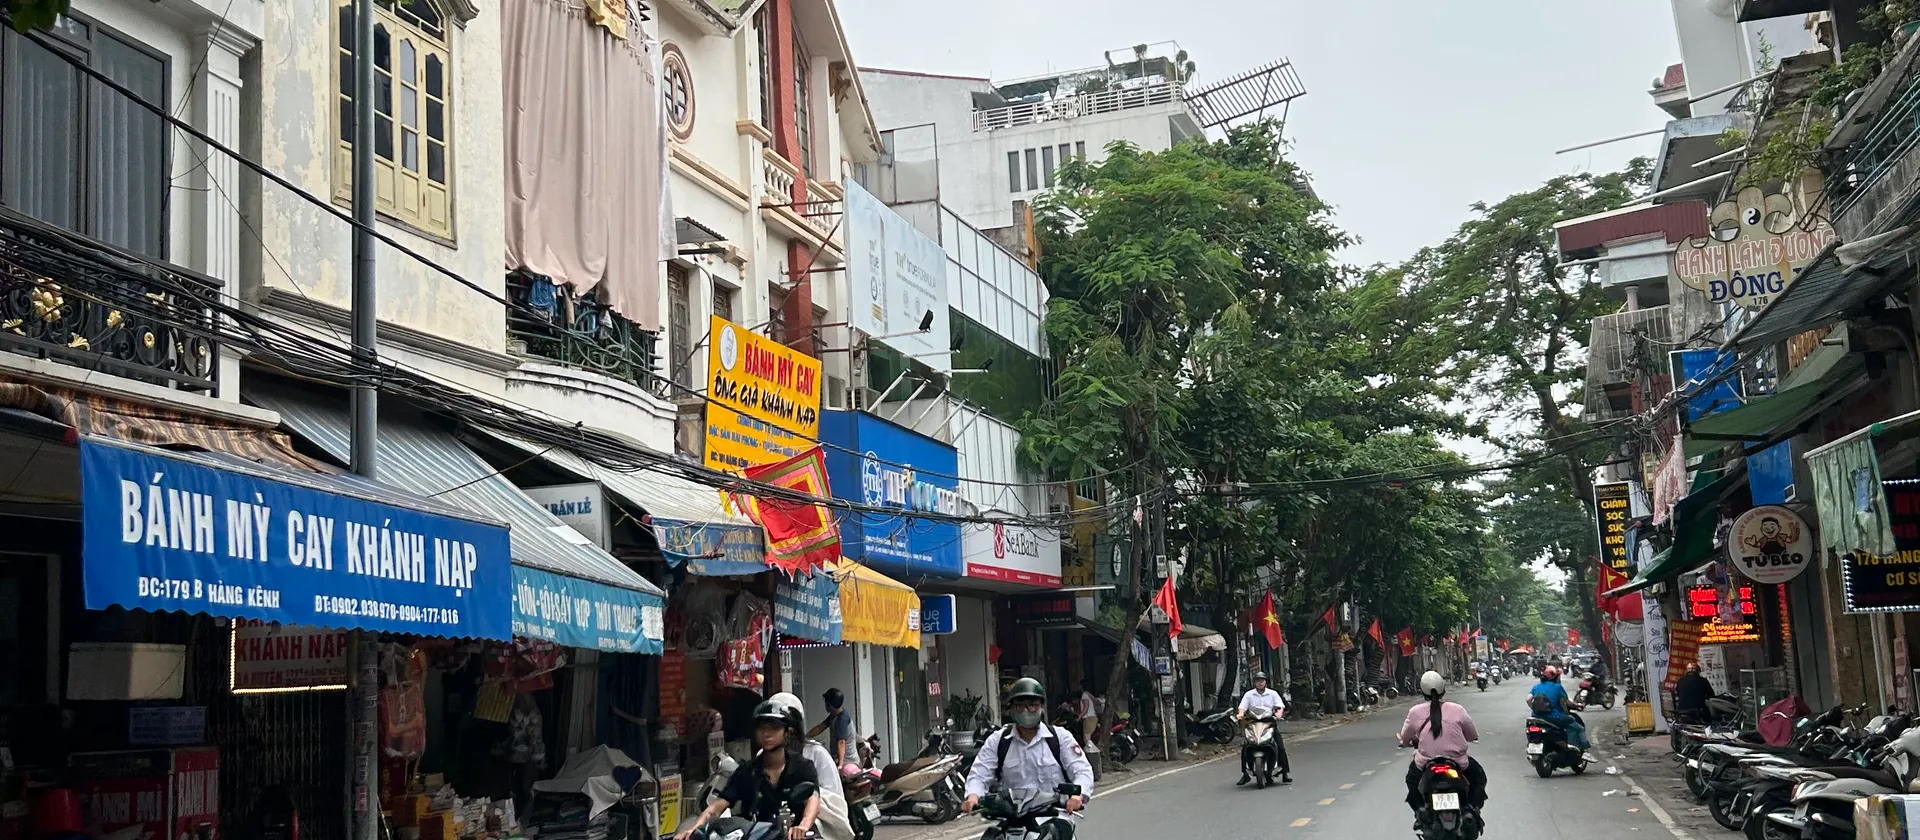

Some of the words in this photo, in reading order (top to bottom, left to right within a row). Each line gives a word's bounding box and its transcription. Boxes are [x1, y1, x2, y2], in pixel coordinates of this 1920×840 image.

[1676, 245, 1728, 283] HẠNH
[1729, 235, 1767, 273] LÂM
[1709, 270, 1784, 301] ĐÔNG
[1753, 296, 1768, 305] 176
[744, 339, 775, 382] BÁNH
[796, 364, 815, 396] CAY
[714, 368, 737, 403] ÔNG
[740, 381, 759, 408] GIÀ
[761, 389, 794, 421] KHÁNH
[121, 473, 215, 555] BÁNH
[226, 492, 271, 562] MỲ
[287, 513, 334, 571] CAY
[346, 518, 426, 584] KHÁNH
[434, 537, 478, 598] NẠP
[1006, 529, 1039, 558] SeABank
[1605, 535, 1625, 544] KHO
[1770, 550, 1804, 567] BÉO
[139, 576, 190, 600] ĐC:179
[194, 579, 203, 598] B
[208, 580, 243, 605] HÀNG
[248, 585, 280, 608] KÊNH
[238, 633, 303, 661] KHÁNH
[309, 633, 348, 663] NẠP
